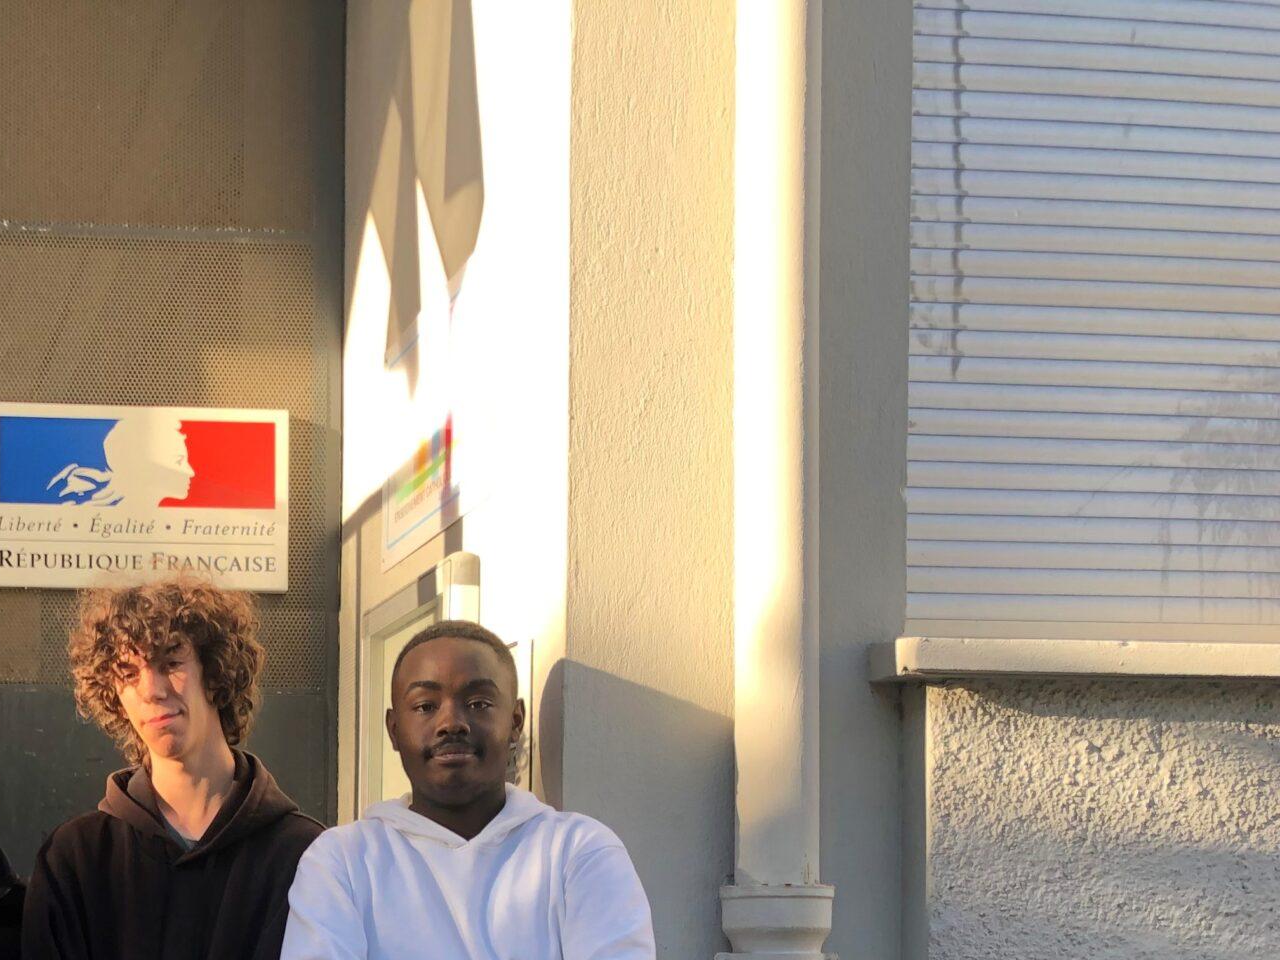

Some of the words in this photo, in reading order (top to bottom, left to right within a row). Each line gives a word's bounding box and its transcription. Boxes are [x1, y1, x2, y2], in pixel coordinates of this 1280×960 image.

[89, 512, 155, 538] Égalité
[182, 518, 276, 537] Fraternité
[151, 551, 277, 576] FRANÇAISE
